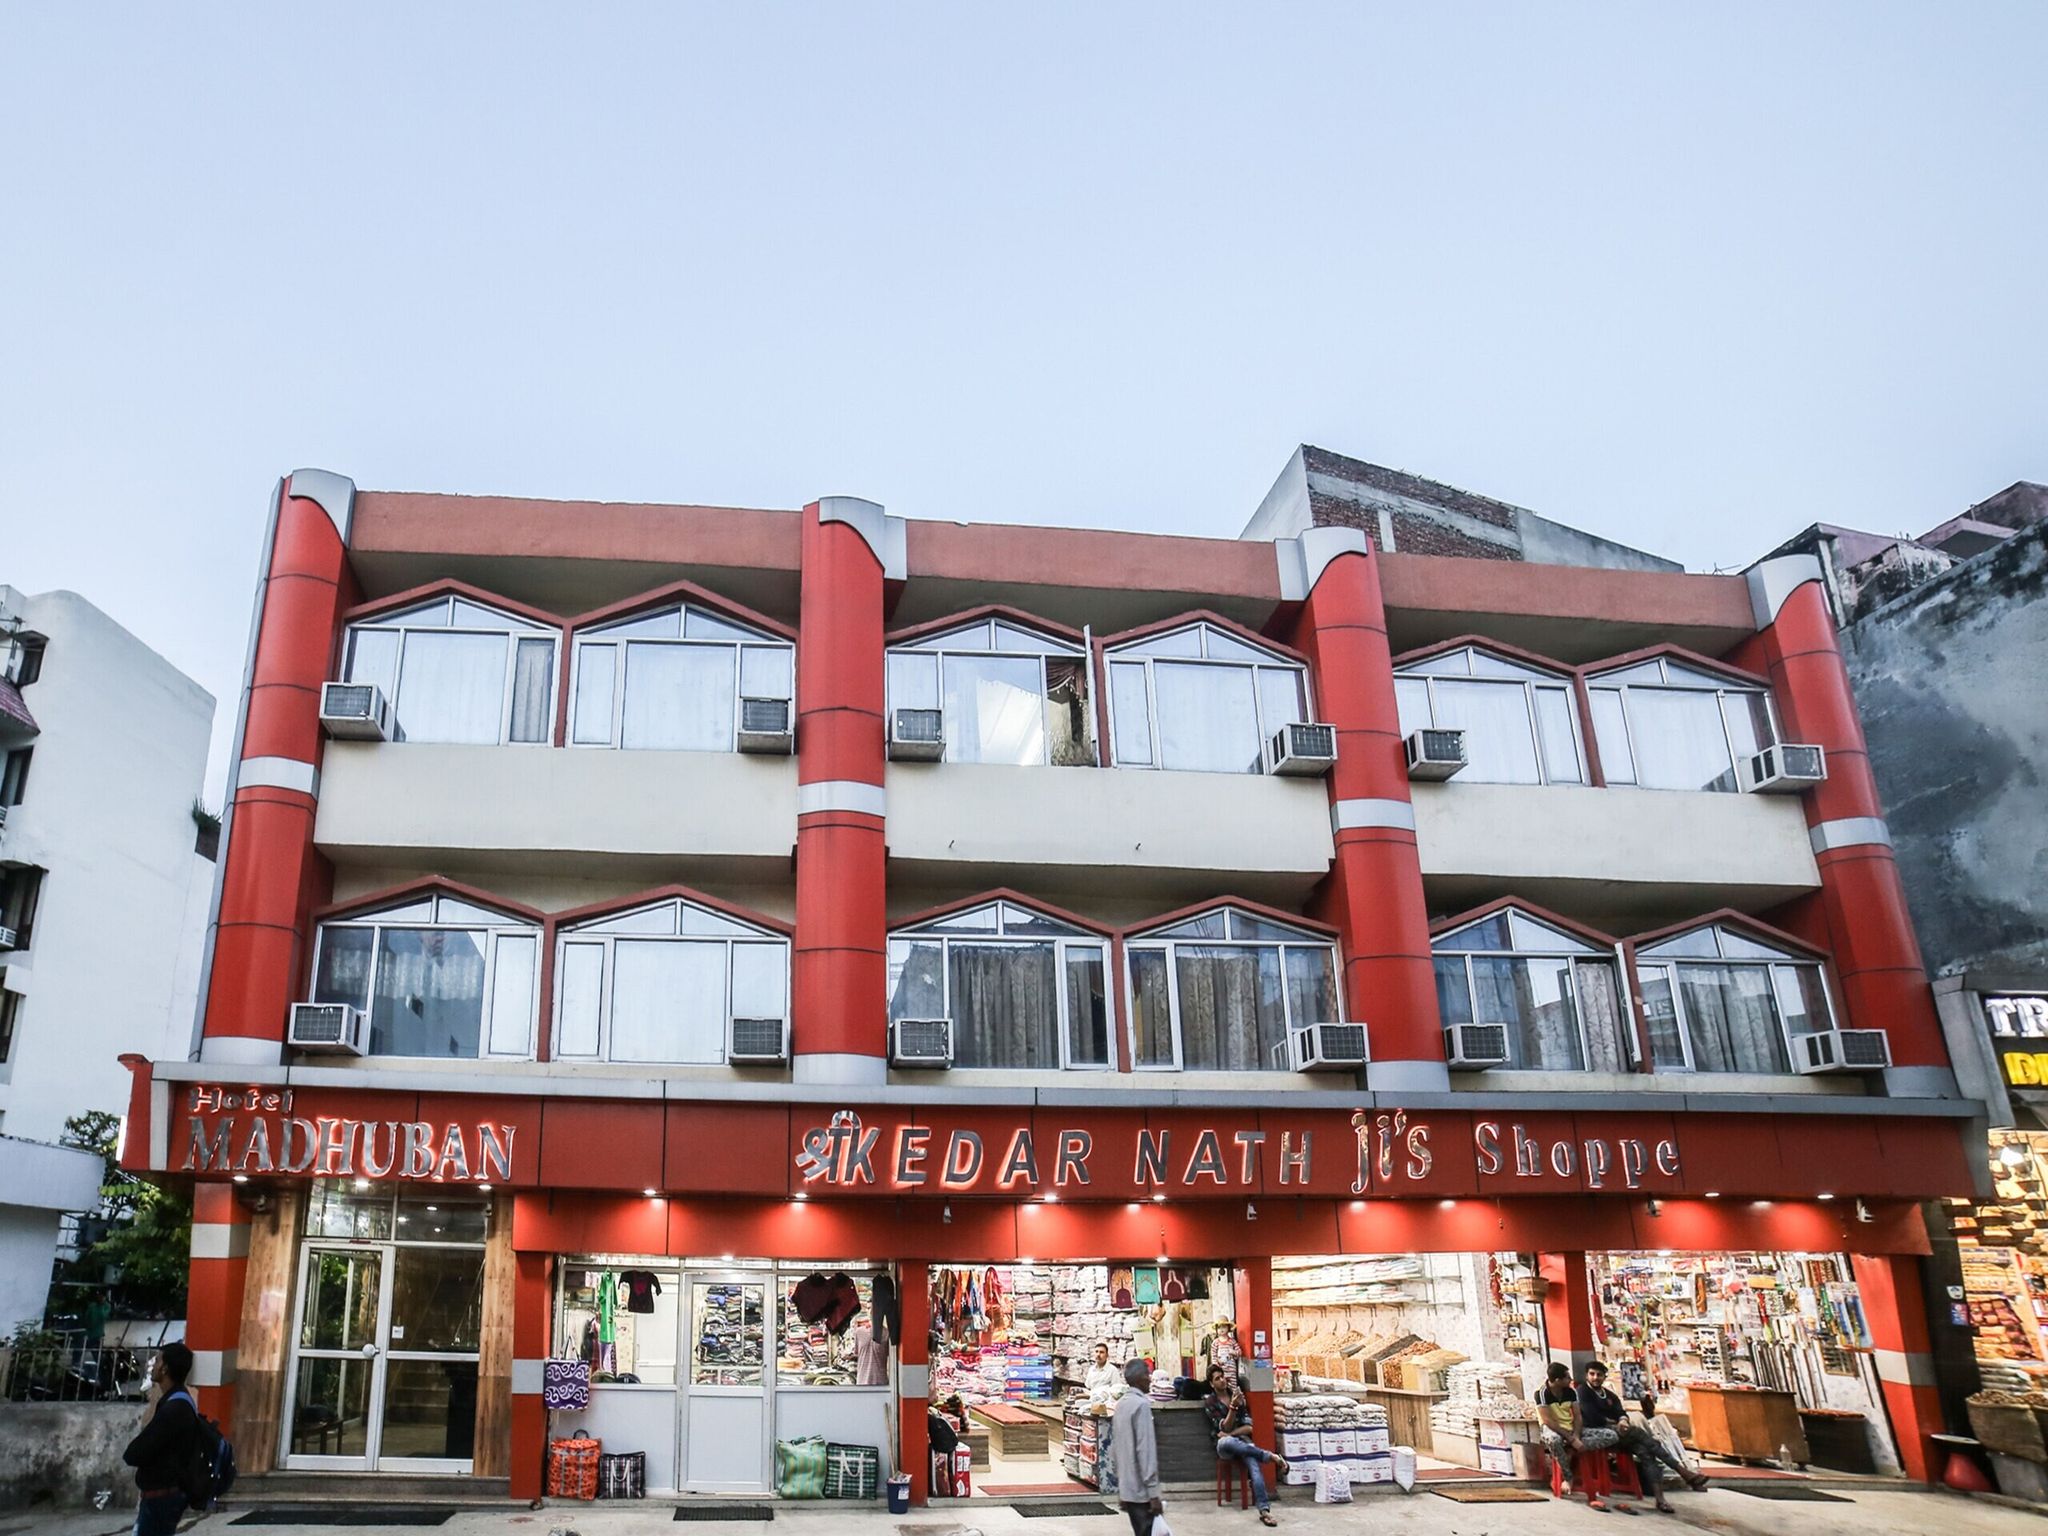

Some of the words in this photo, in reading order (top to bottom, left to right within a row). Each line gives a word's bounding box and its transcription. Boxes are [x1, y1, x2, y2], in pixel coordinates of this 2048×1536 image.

[188, 1086, 294, 1113] Hotel
[181, 1115, 518, 1182] MADHUBAN
[843, 1126, 1092, 1187] KEDAR
[1133, 1128, 1314, 1186] NATH
[1474, 1121, 1680, 1188] Shoppe
